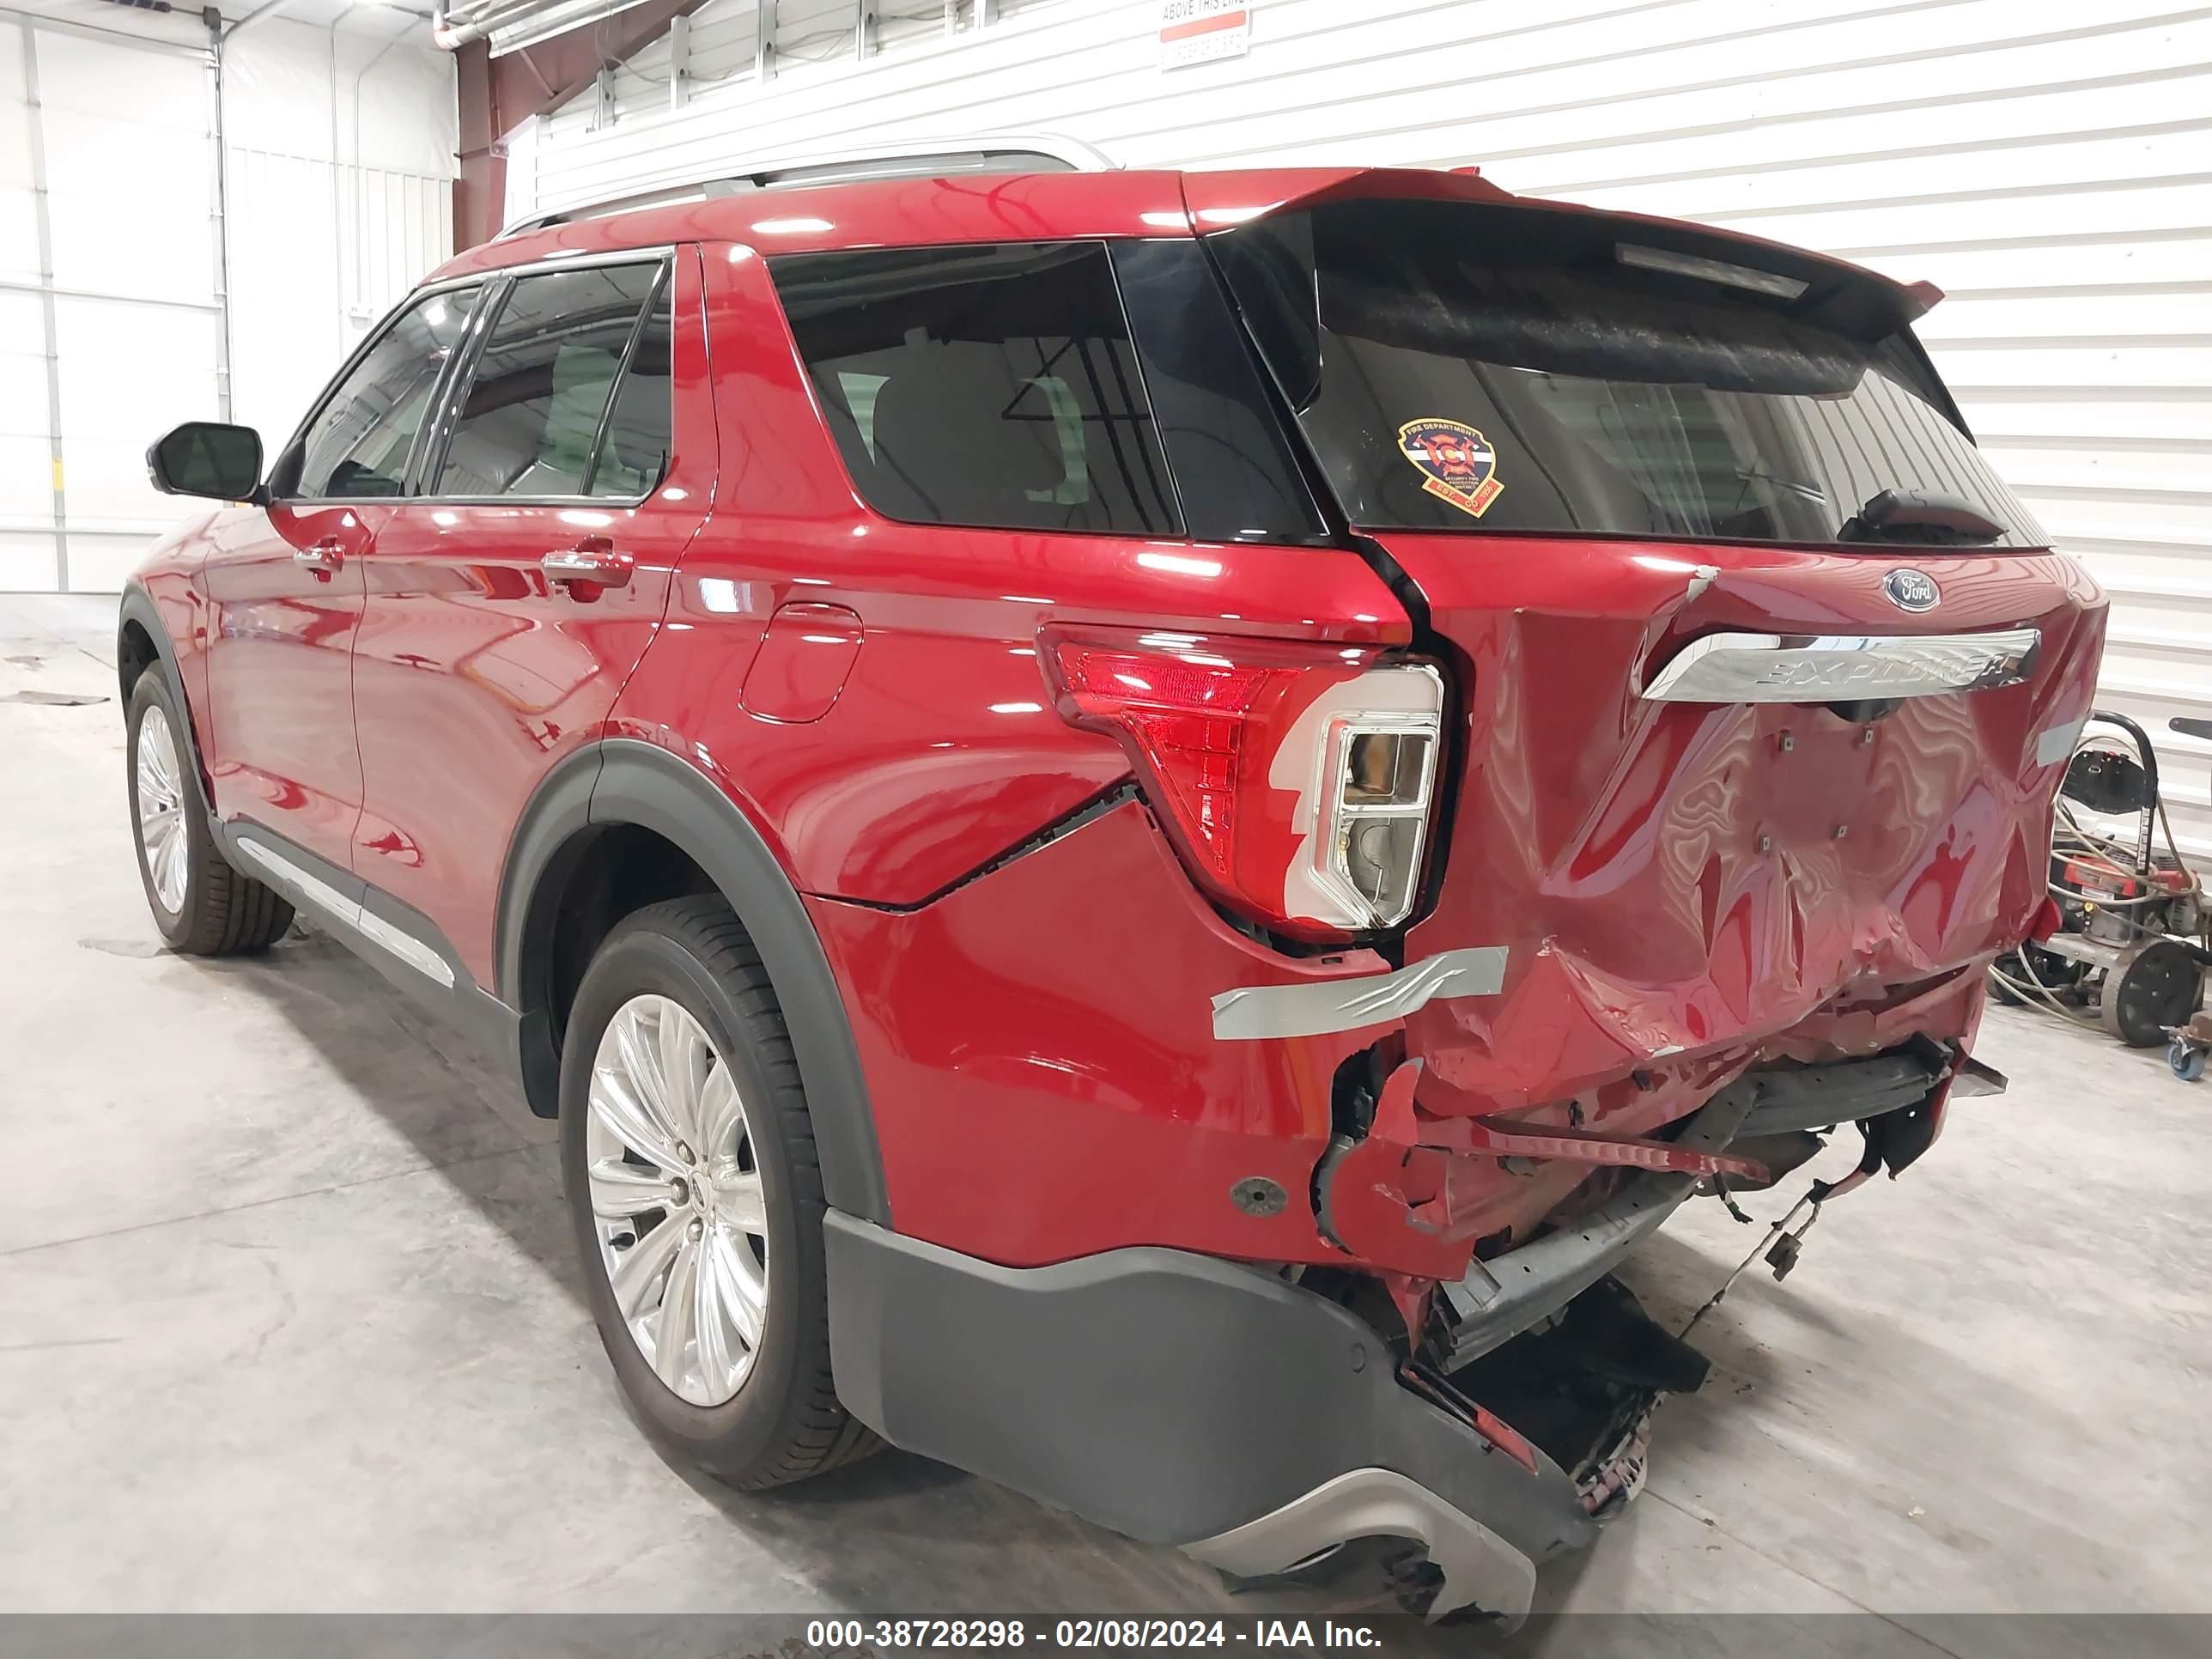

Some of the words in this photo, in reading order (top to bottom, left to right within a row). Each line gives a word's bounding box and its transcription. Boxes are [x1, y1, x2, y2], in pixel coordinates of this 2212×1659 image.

[1163, 0, 1194, 21] ABOVE
[1199, 0, 1219, 13] THIS
[1406, 425, 1424, 435] FIRE
[1422, 422, 1477, 438] DEPARTMENT
[1435, 483, 1455, 500] EST.
[1901, 576, 1932, 601] Ford
[1753, 653, 2009, 685] EXPLORER
